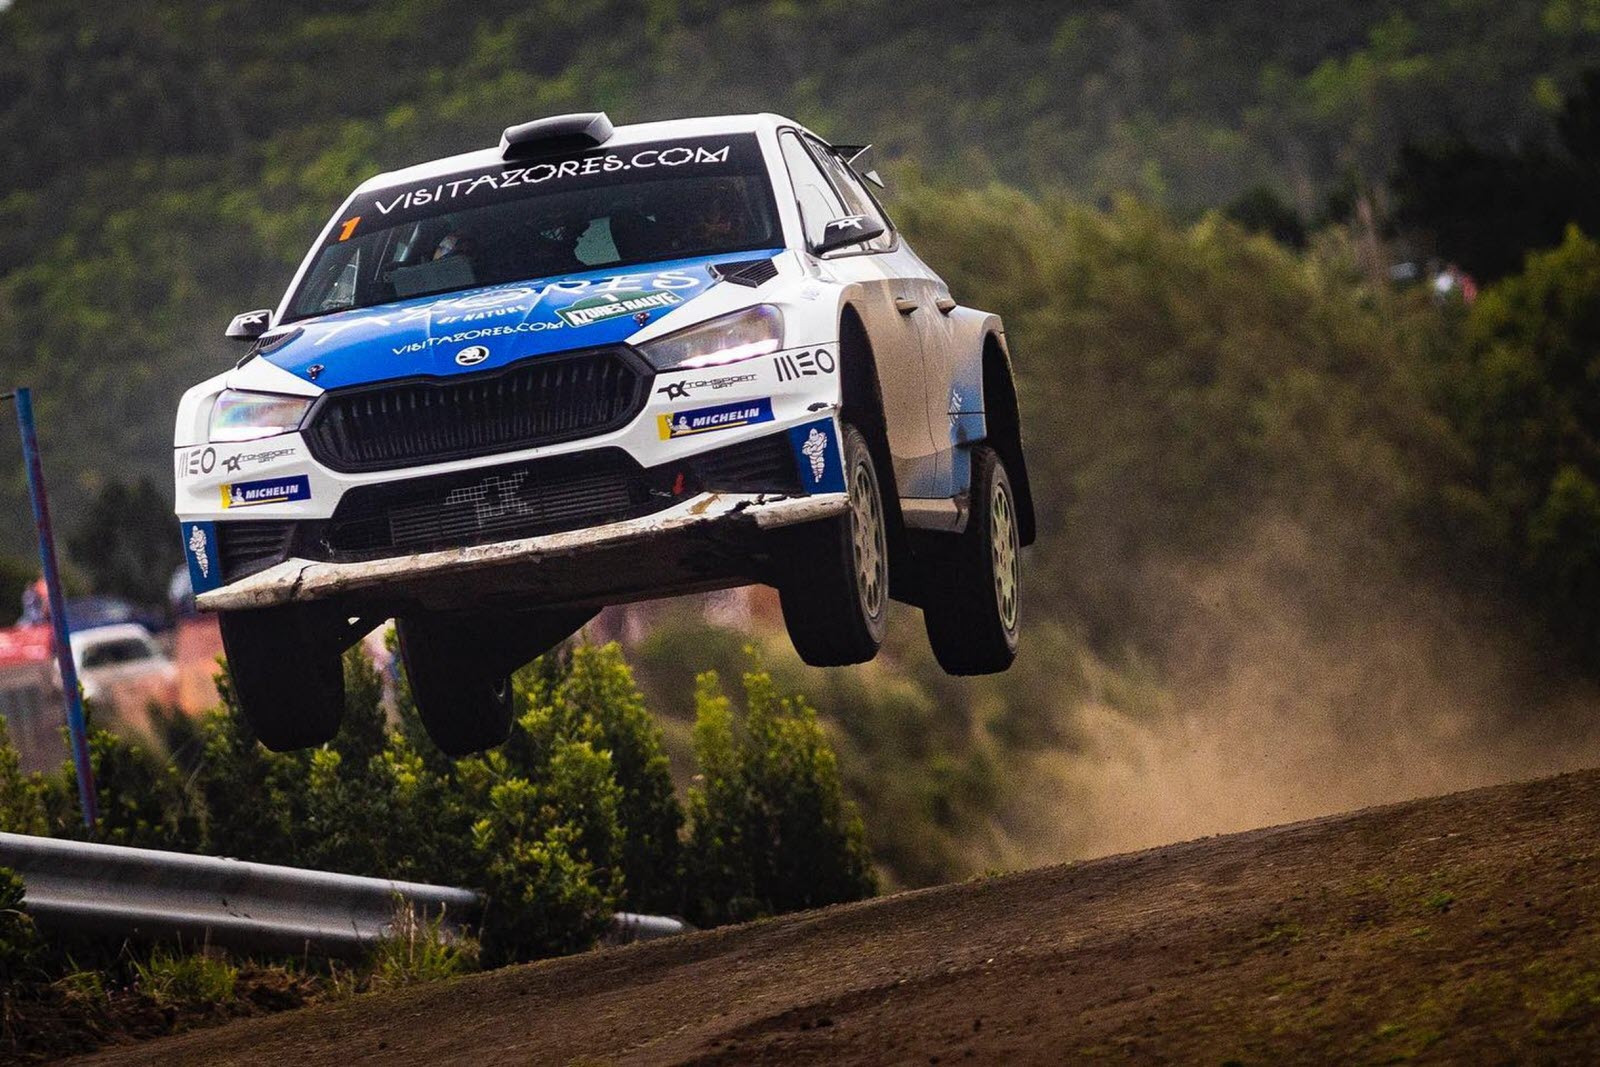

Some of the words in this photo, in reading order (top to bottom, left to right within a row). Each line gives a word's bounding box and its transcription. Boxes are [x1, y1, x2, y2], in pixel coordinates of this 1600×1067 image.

[373, 145, 731, 215] VISITAZORES.COM
[338, 215, 361, 242] 1
[463, 305, 529, 322] NATURE
[565, 303, 628, 326] AZORES
[621, 291, 677, 311] RALLYE
[392, 320, 564, 356] VISITAZORES.COM
[773, 348, 836, 383] MEO
[692, 407, 760, 428] MICHELIN
[245, 484, 299, 500] MICHELIN
